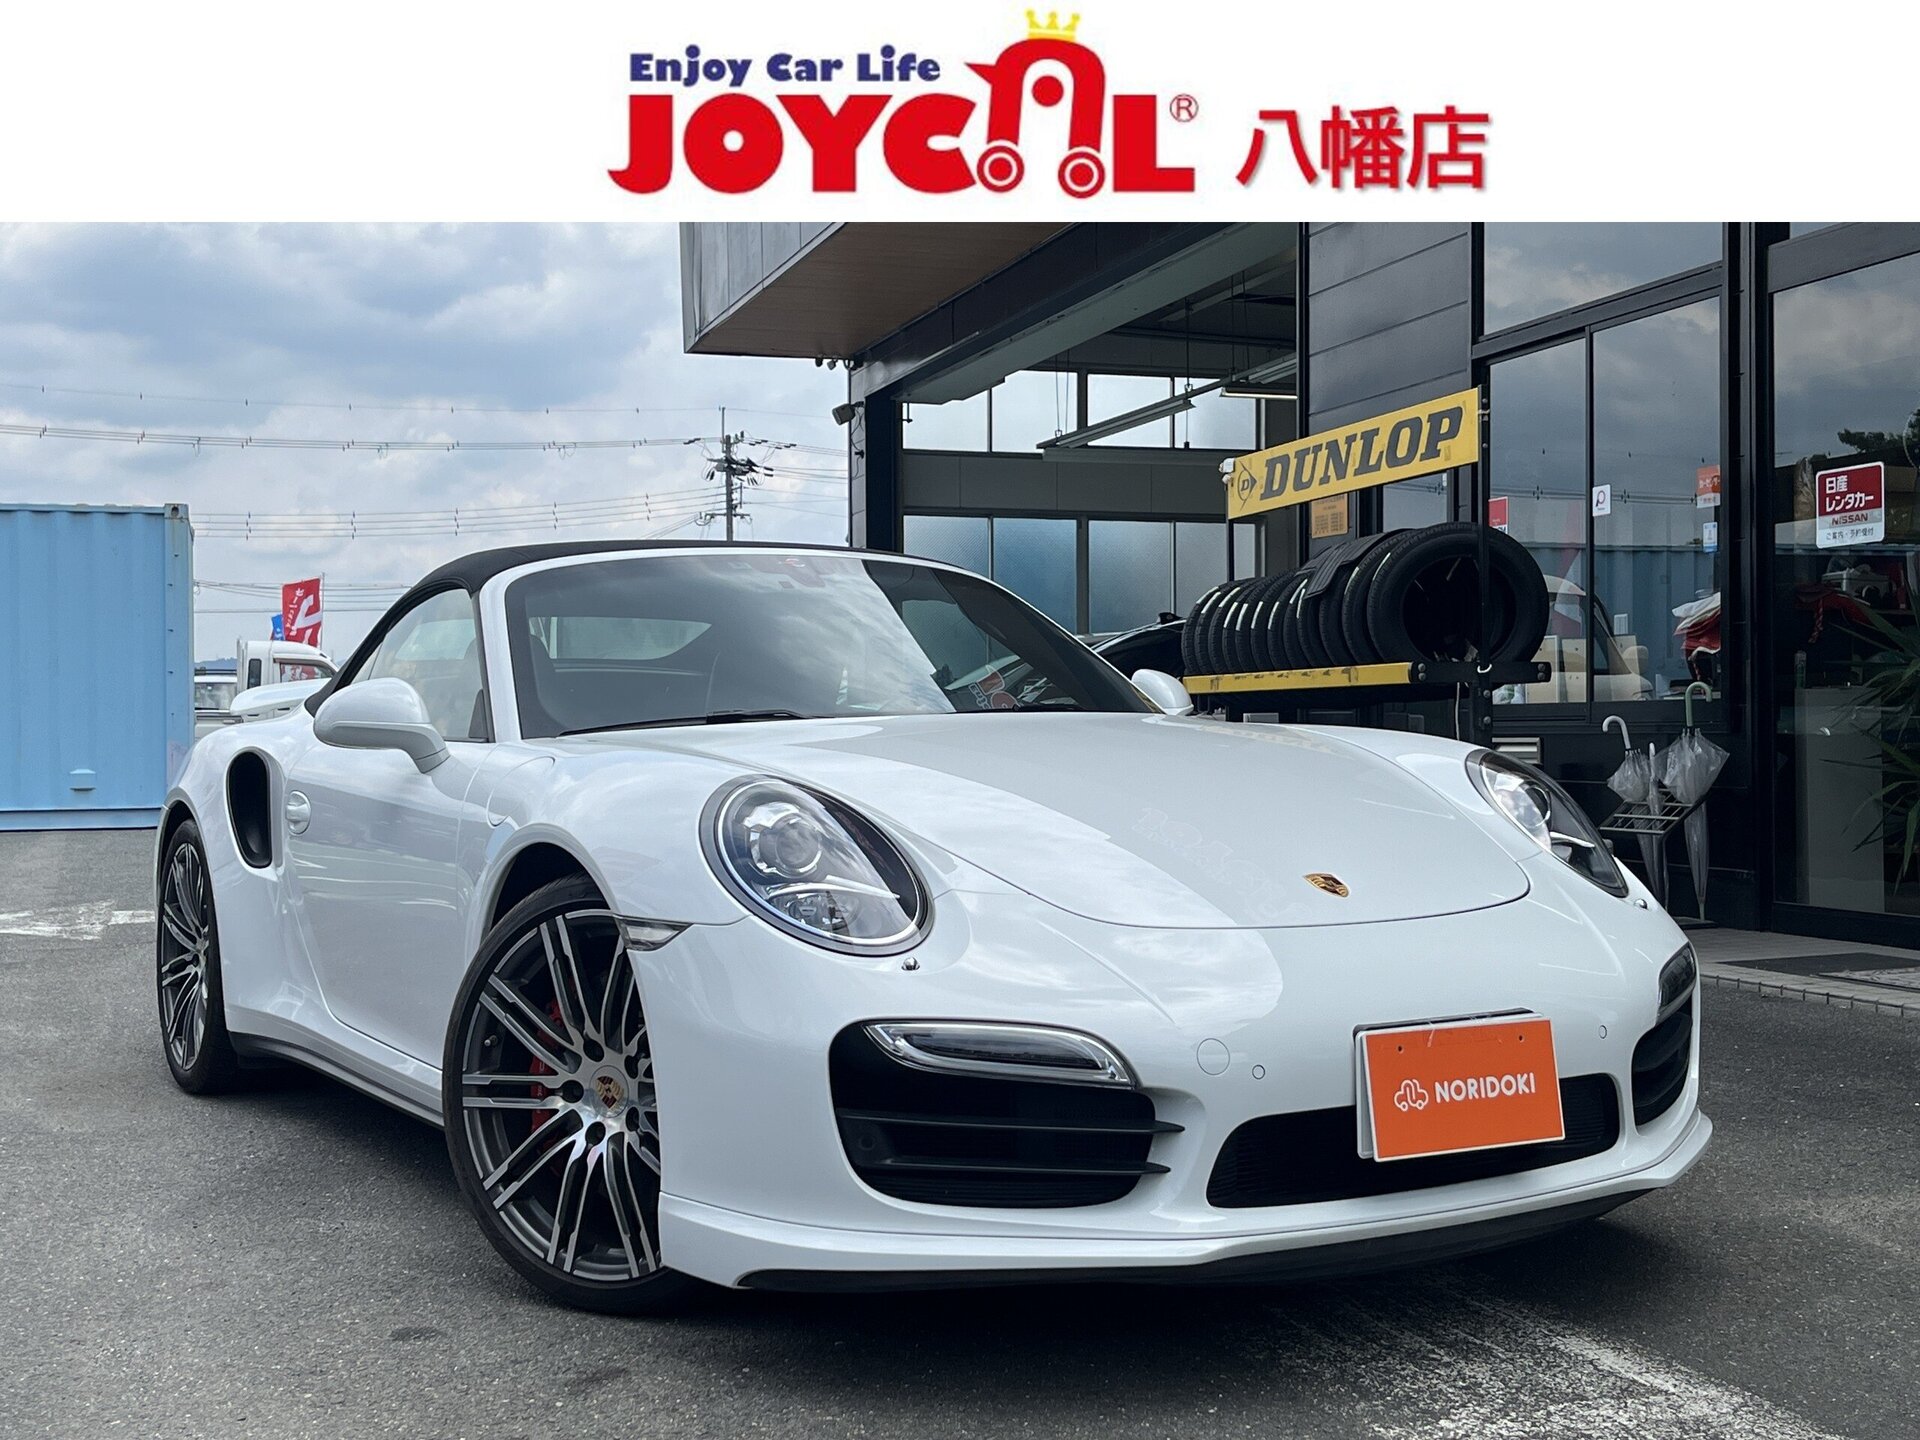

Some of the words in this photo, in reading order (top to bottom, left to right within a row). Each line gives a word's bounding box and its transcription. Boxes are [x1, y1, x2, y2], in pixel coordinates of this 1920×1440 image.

[1260, 406, 1463, 501] DUNLOP
[1825, 475, 1848, 494] 日産
[1825, 491, 1874, 513] レンタカー
[1831, 513, 1868, 526] NISSAN
[1434, 1072, 1536, 1104] NORIDOKI
